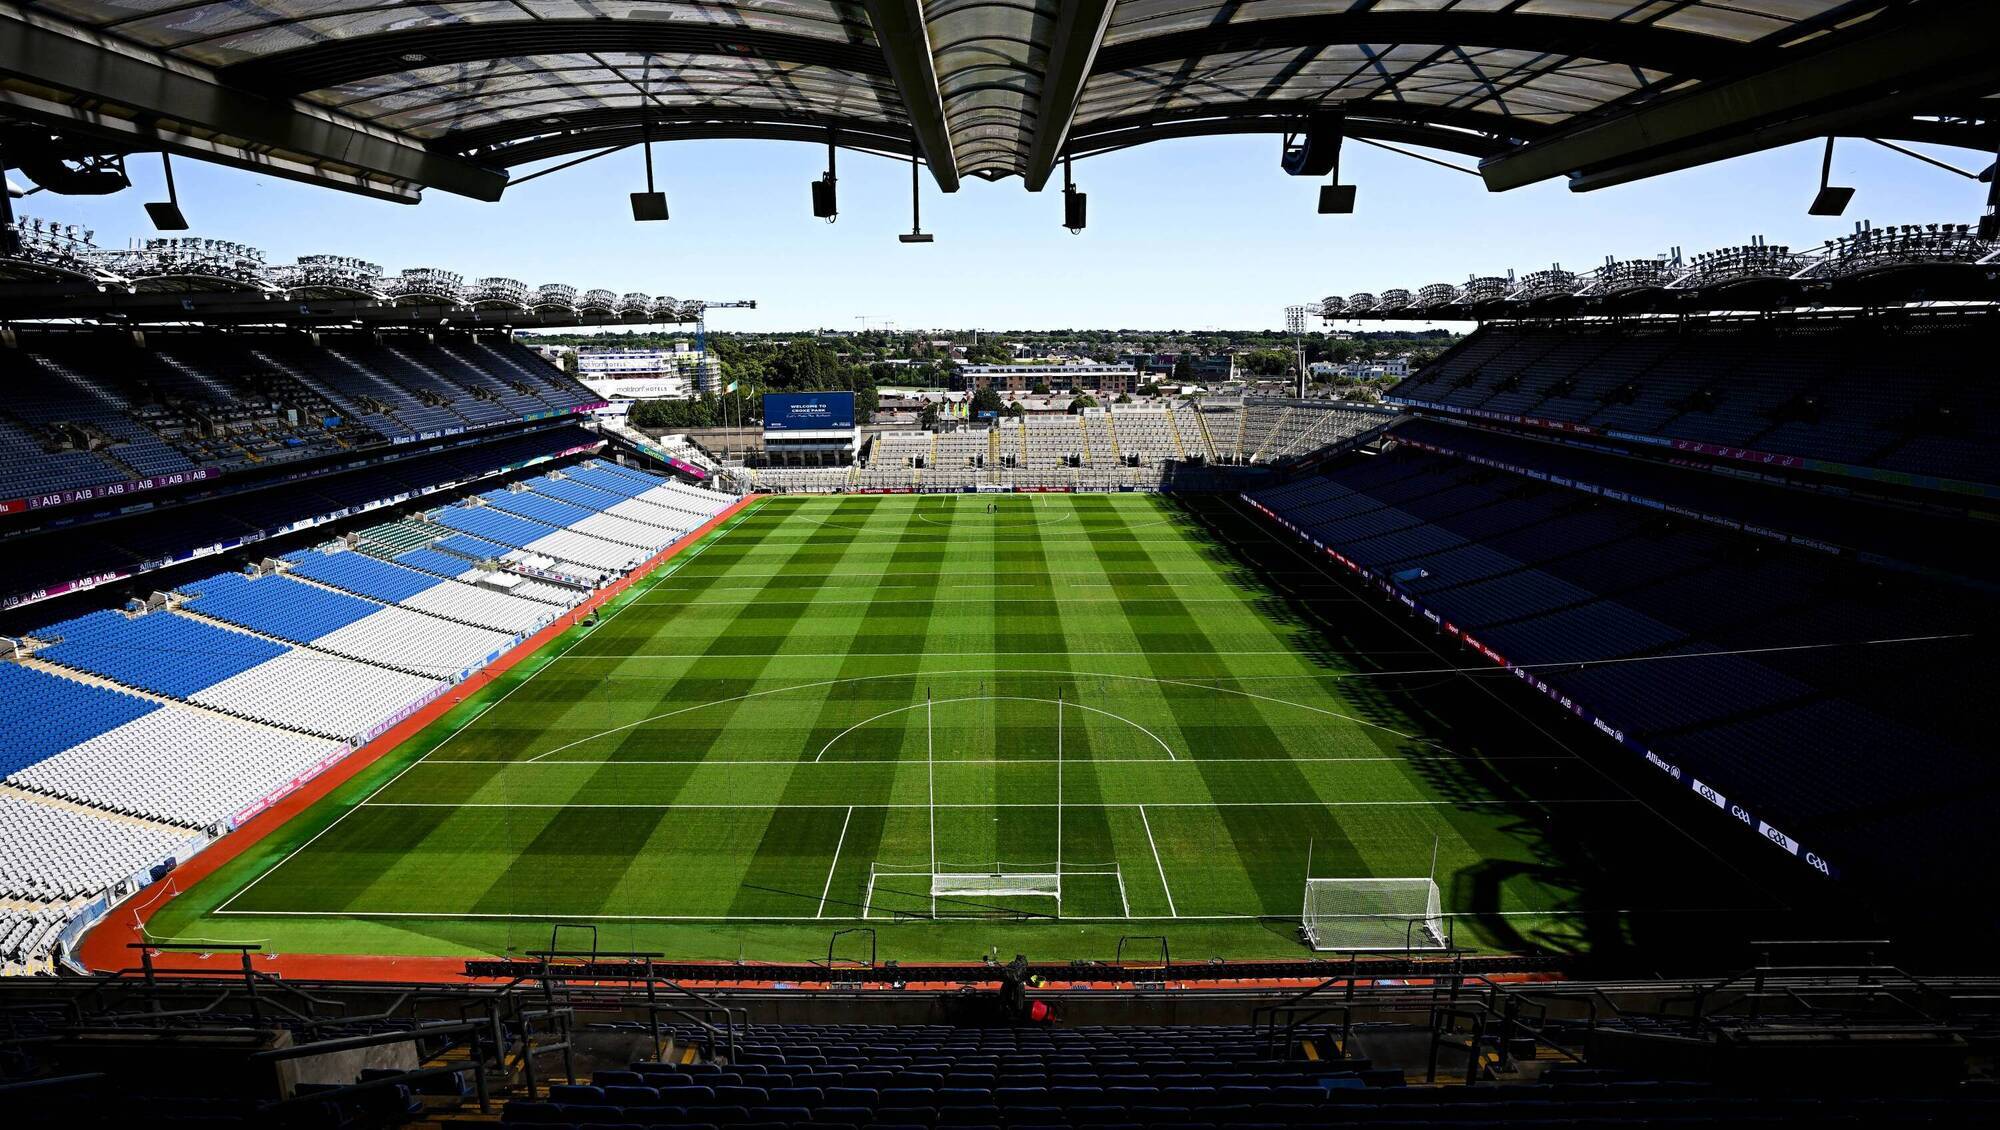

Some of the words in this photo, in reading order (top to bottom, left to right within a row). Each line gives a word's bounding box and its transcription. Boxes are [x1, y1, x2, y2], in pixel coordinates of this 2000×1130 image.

[643, 447, 664, 461] Centro
[168, 475, 183, 485] AIB
[193, 470, 206, 480] AIB
[108, 484, 124, 495] AIB
[138, 480, 153, 490] AIB
[42, 494, 61, 507] AIB
[75, 489, 92, 501] AIB
[78, 577, 93, 587] AIB
[102, 572, 116, 581] AIB
[31, 590, 47, 601] AIB
[3, 597, 19, 608] AIB
[1514, 667, 1525, 678] AIB
[1537, 681, 1547, 693] AIB
[1560, 696, 1571, 709] AIB
[1593, 717, 1615, 737] Allianz
[1646, 750, 1670, 773] Allianz
